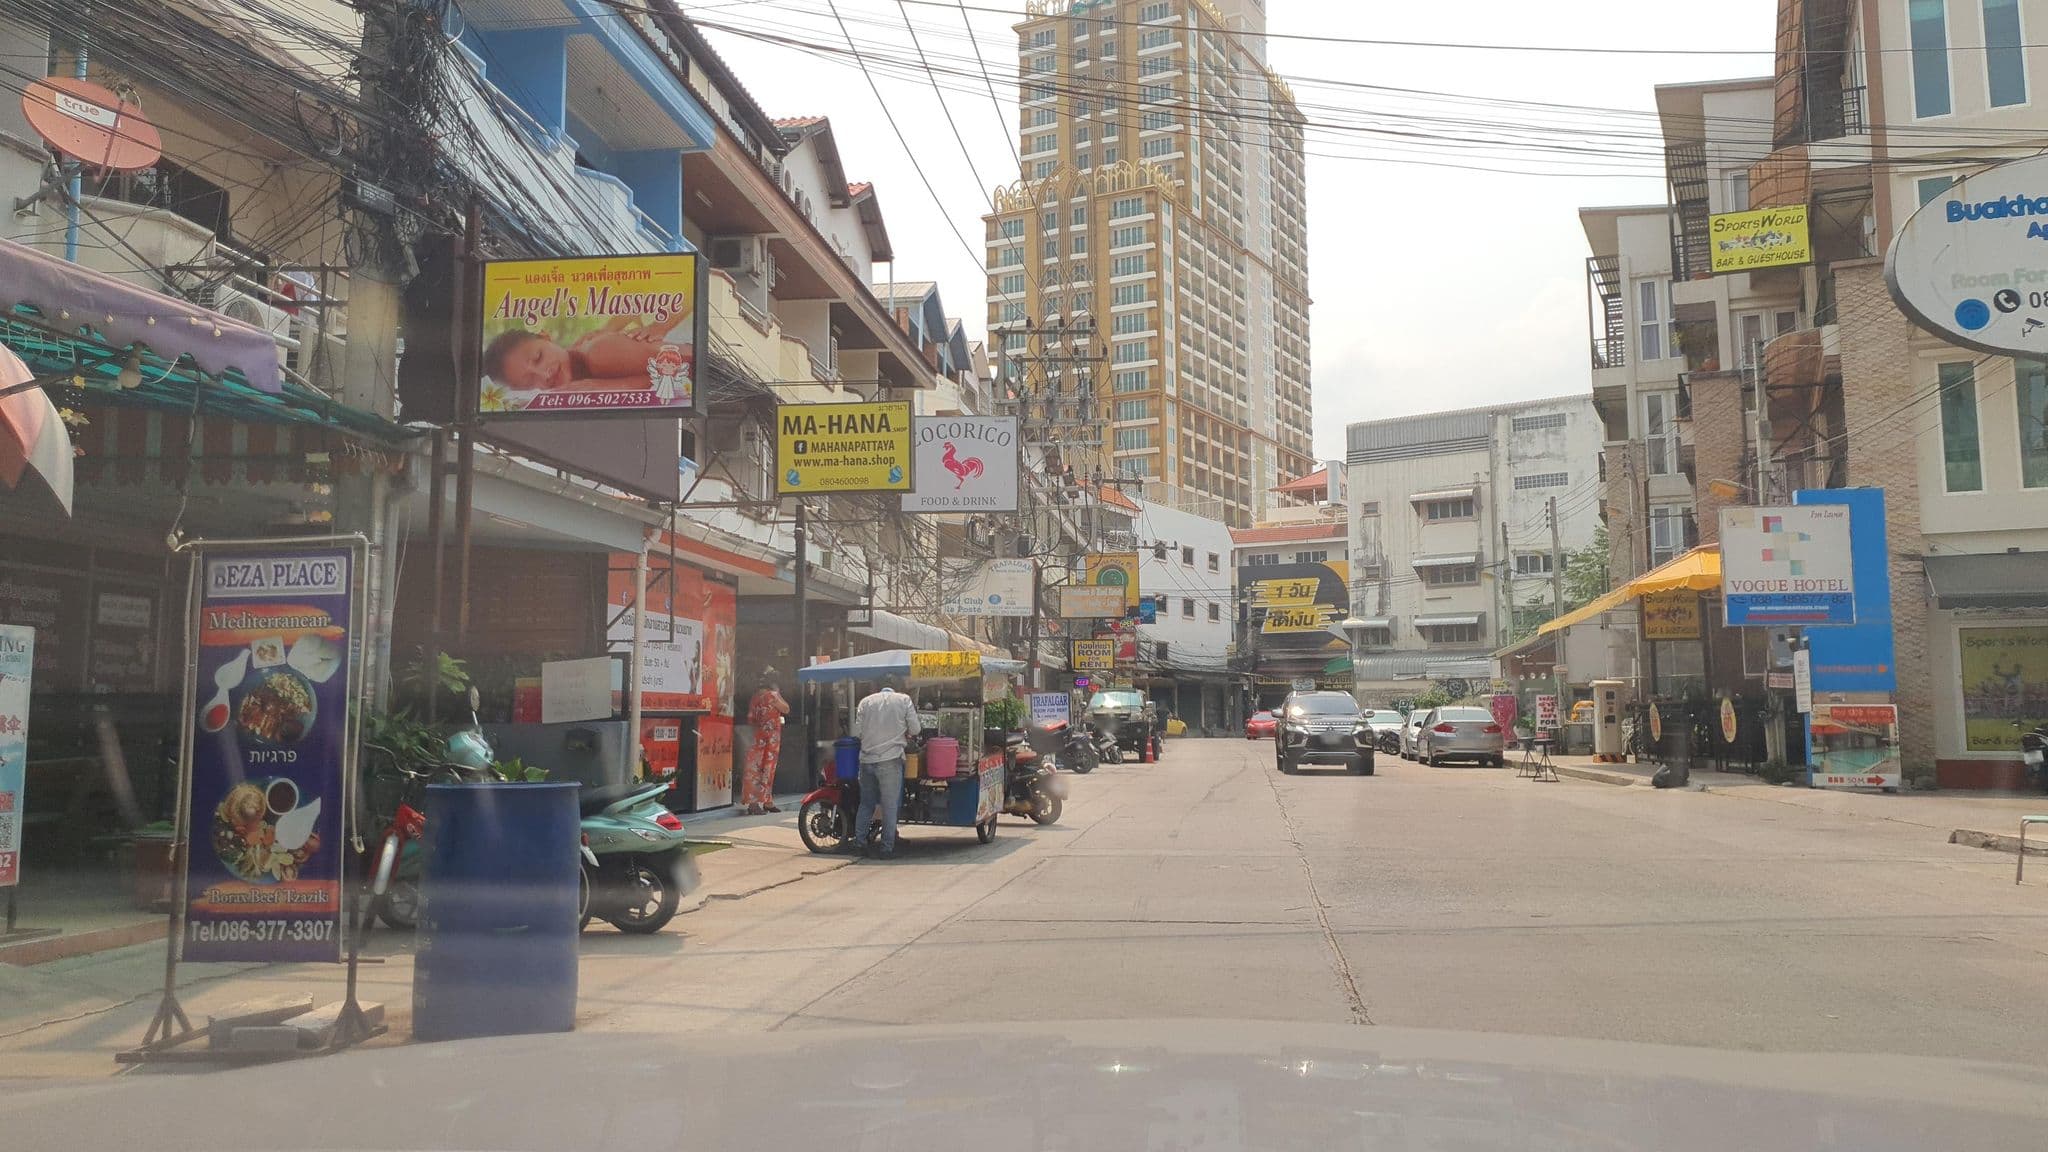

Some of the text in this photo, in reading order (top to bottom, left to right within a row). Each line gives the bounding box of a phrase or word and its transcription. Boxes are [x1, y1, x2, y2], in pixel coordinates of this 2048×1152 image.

[63, 97, 100, 116] true
[1716, 249, 1805, 268] BAR & GUESTHOUSE
[493, 286, 684, 326] Angel's Massage
[539, 392, 652, 407] Tel: 096-5027533
[782, 413, 892, 436] MA-HANA
[811, 439, 895, 453] MAHANAPATTAYA
[794, 455, 896, 468] www.ma-hana.shop
[819, 477, 870, 486] 0804600098
[920, 496, 998, 506] FOOD & DRINK
[272, 562, 337, 587] PLACE
[1731, 578, 1849, 592] VOGUE HOTEL
[208, 611, 329, 630] Mediterranean
[1033, 695, 1068, 706] TRAFALGAR
[249, 749, 298, 764] פרגיות
[249, 888, 280, 904] Beef
[190, 919, 334, 942] Tel.086-377-3307
